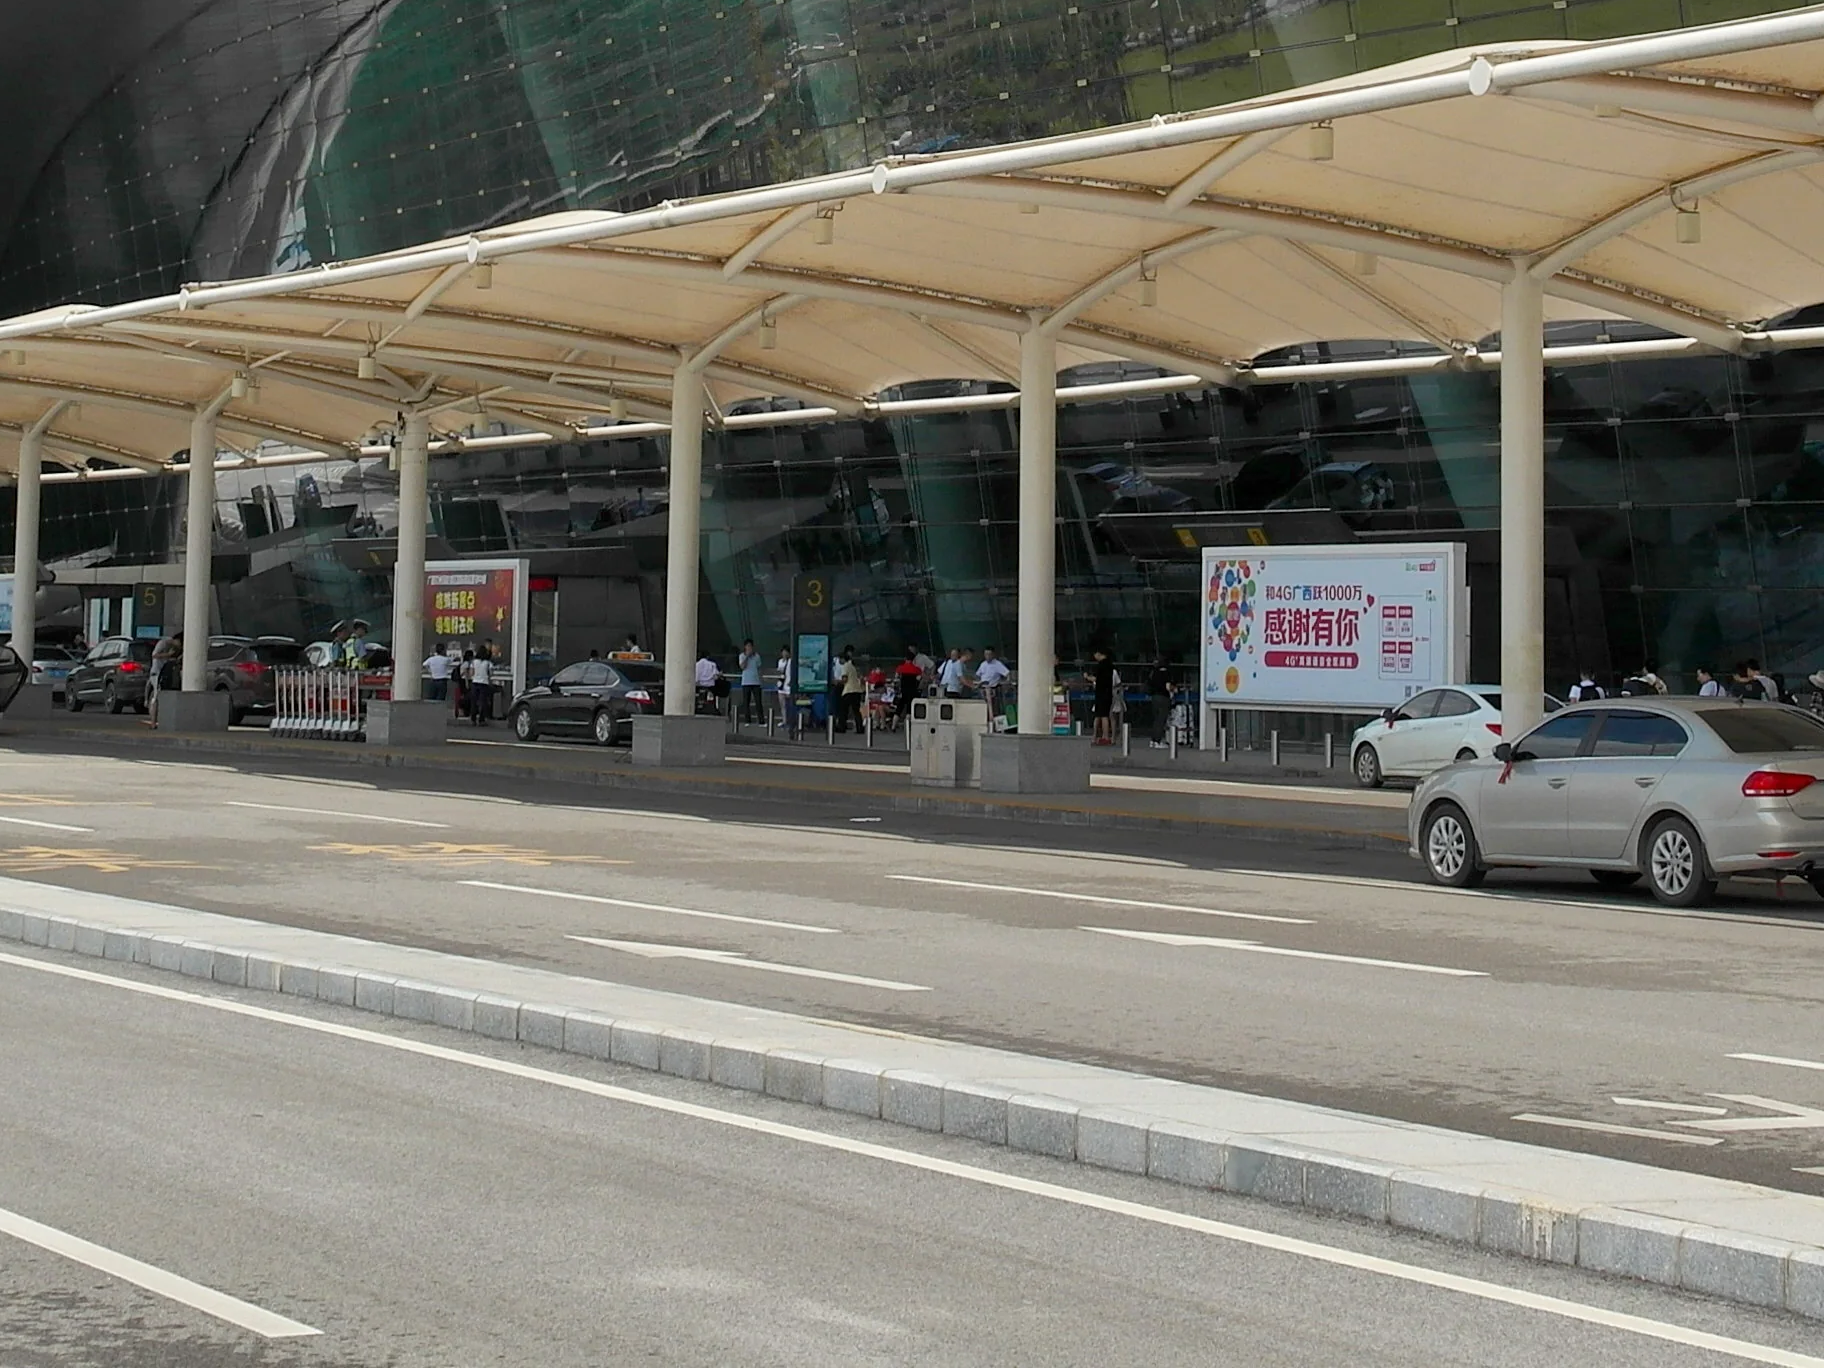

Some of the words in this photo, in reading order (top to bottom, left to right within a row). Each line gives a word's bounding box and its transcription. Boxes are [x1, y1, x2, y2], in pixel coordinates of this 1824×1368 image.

[143, 587, 157, 607] 5
[806, 579, 824, 608] 3
[1265, 585, 1363, 601] 和4G广西跃1000万
[1264, 608, 1360, 647] 感谢有你
